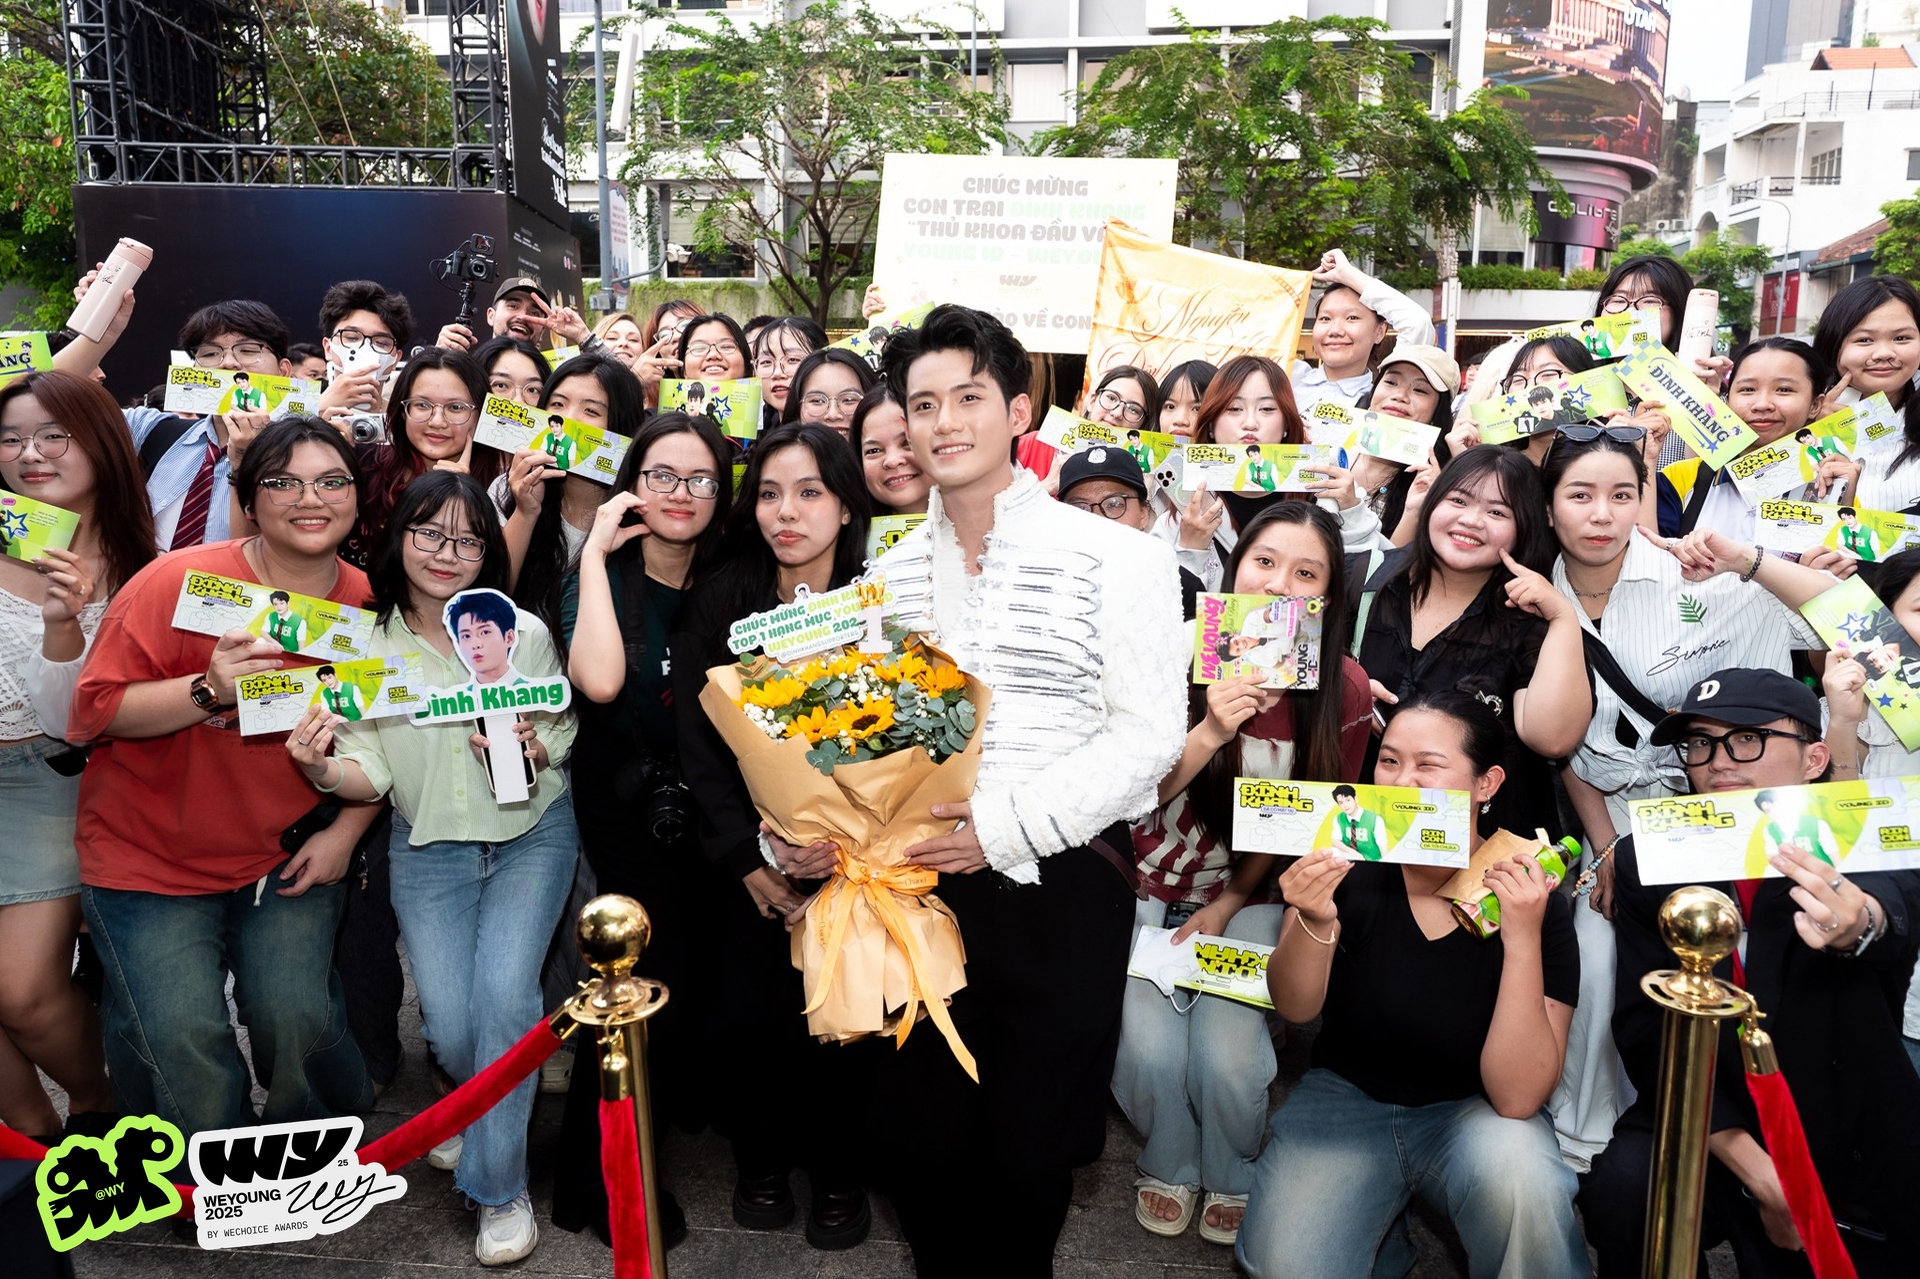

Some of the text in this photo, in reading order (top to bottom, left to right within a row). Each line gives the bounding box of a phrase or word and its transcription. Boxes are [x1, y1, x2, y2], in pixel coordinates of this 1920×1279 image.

[1624, 5, 1657, 33] UTAH
[963, 174, 1089, 196] CHÚC MỪNG
[903, 197, 1147, 219] CON TRAI ĐÌNH KHANG
[964, 222, 1026, 240] KHOA
[1030, 217, 1077, 241] ĐẦU
[903, 243, 977, 260] YOUNG
[982, 245, 1004, 262] ID
[1023, 307, 1048, 328] VỀ
[1052, 314, 1092, 330] CON
[1681, 396, 1730, 442] KHANG
[732, 634, 757, 651] TOP
[759, 629, 766, 641] 1
[768, 618, 803, 639] HẠNG
[804, 611, 832, 630] MỤC
[734, 615, 768, 636] CHÚC
[770, 604, 806, 624] MỪNG
[767, 616, 867, 653] WEYOUNG 202
[1297, 643, 1309, 687] YOUNG
[481, 682, 563, 712] Khang
[1697, 680, 1720, 701] D
[1194, 942, 1270, 971] KHAN
